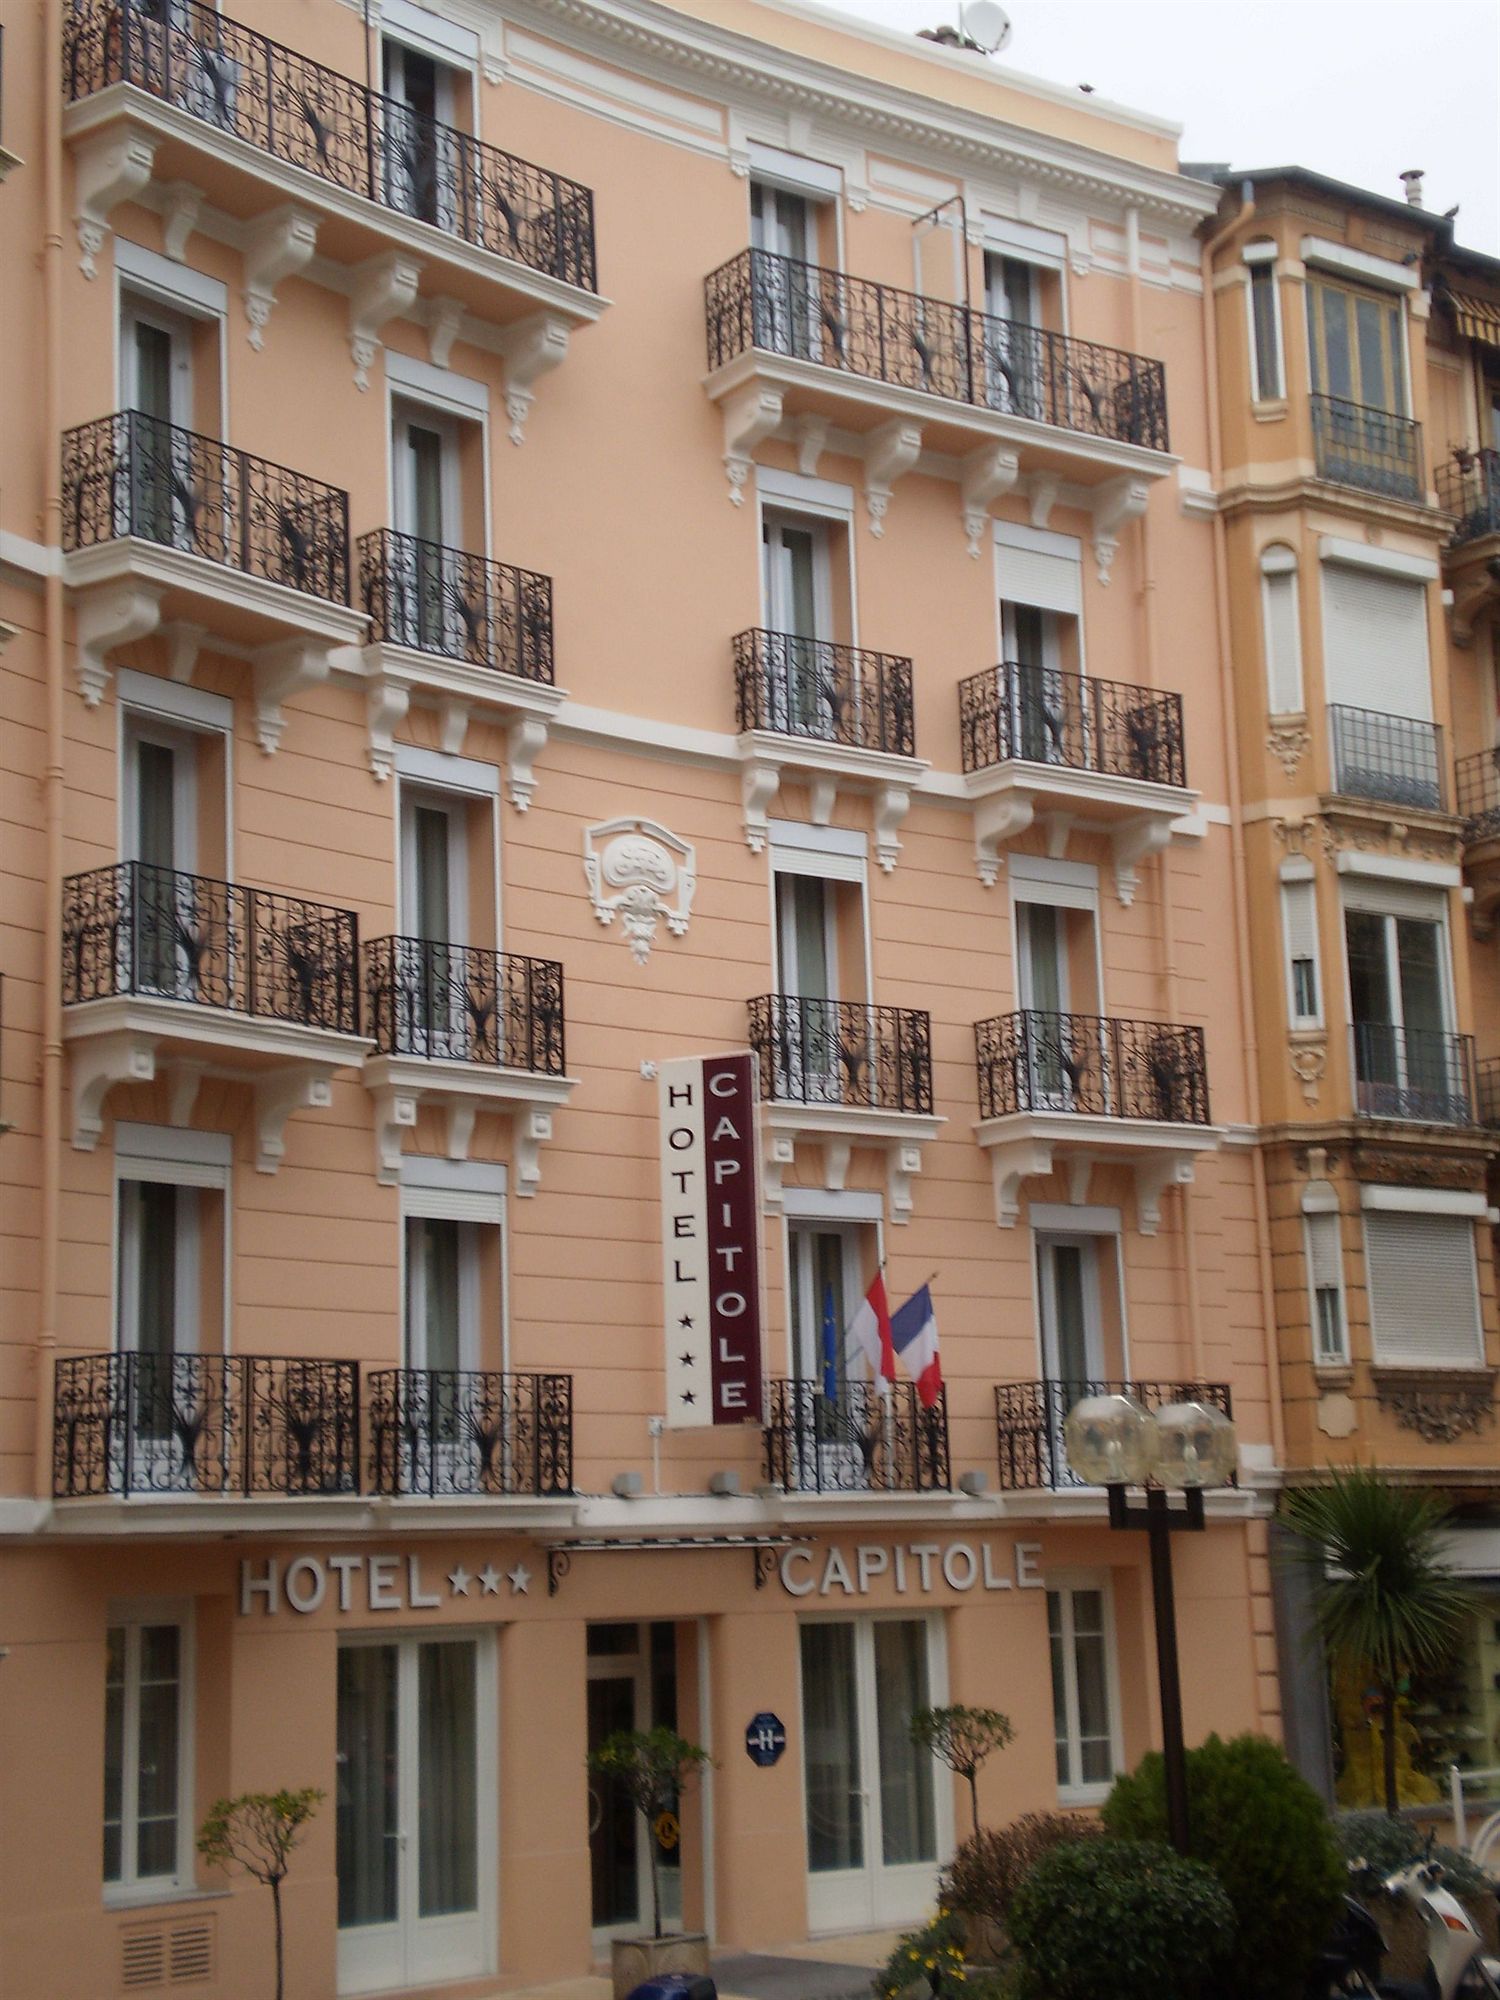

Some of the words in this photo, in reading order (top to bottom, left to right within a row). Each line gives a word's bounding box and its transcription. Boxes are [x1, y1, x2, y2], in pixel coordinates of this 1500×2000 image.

[668, 1083, 697, 1284] HOTEL
[708, 1072, 748, 1409] CAPITOLE
[240, 1554, 442, 1616] HOTEL
[780, 1542, 1046, 1597] CAPITOLE
[758, 1729, 774, 1751] H
